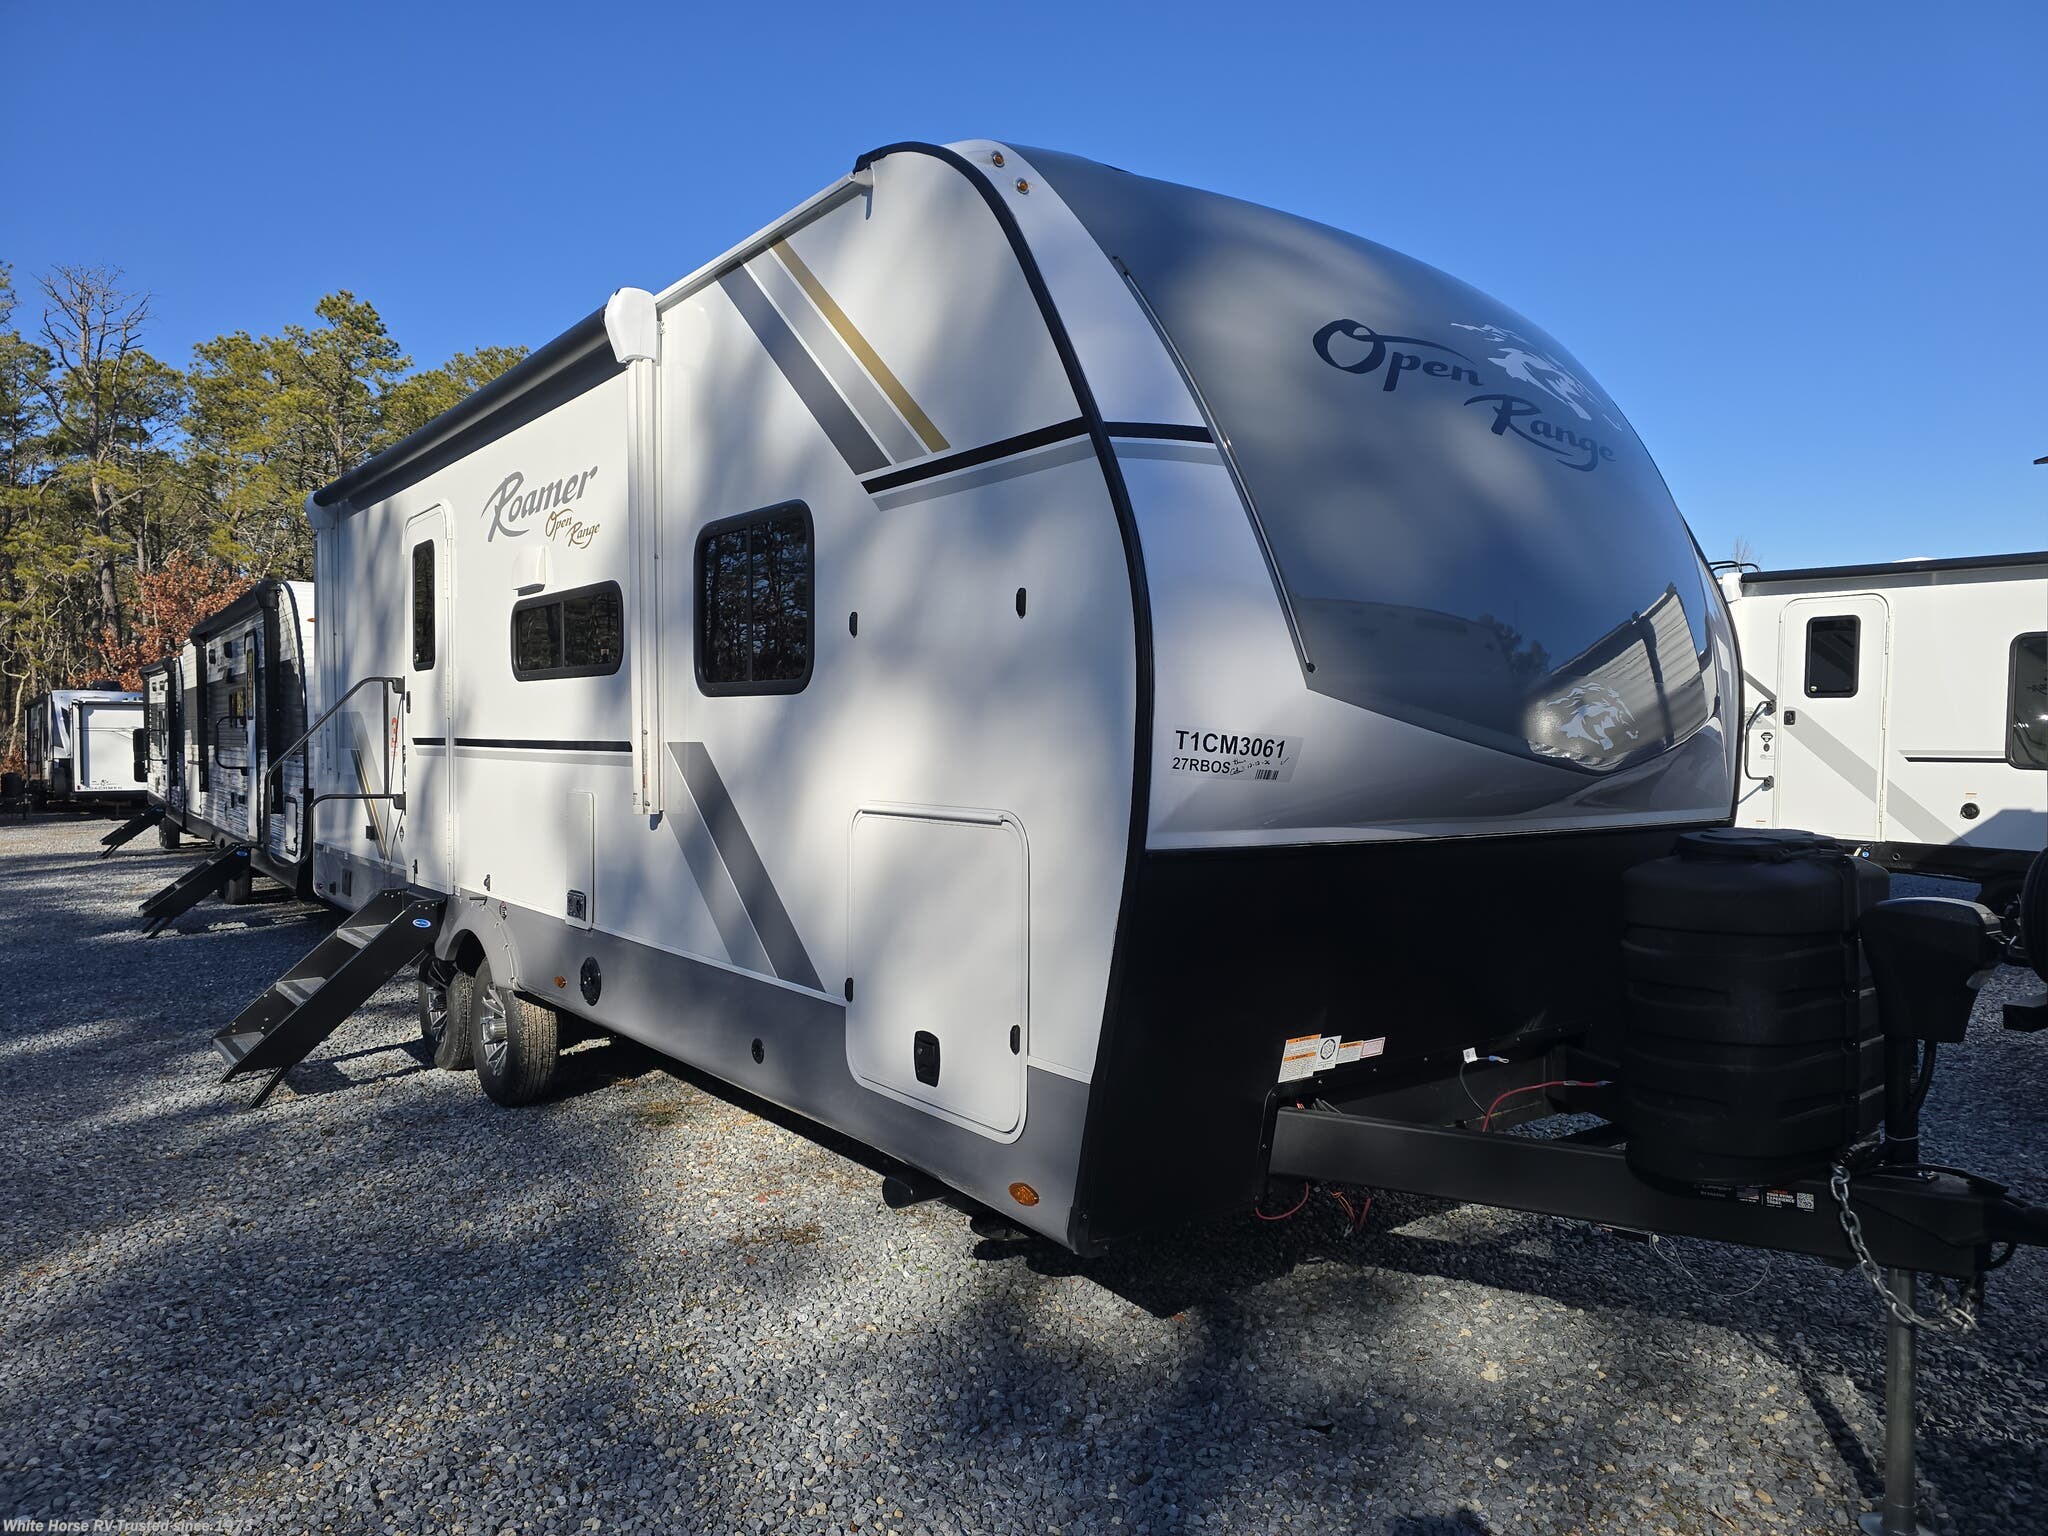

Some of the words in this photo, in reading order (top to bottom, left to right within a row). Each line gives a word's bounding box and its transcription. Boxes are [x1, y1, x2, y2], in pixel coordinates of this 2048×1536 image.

[1313, 319, 1484, 392] Open
[1463, 395, 1616, 472] Range
[481, 466, 598, 542] Roamer
[545, 508, 574, 541] Open
[565, 521, 600, 549] Range
[1175, 730, 1286, 758] T1CM3061
[1172, 757, 1231, 774] 27RBOS
